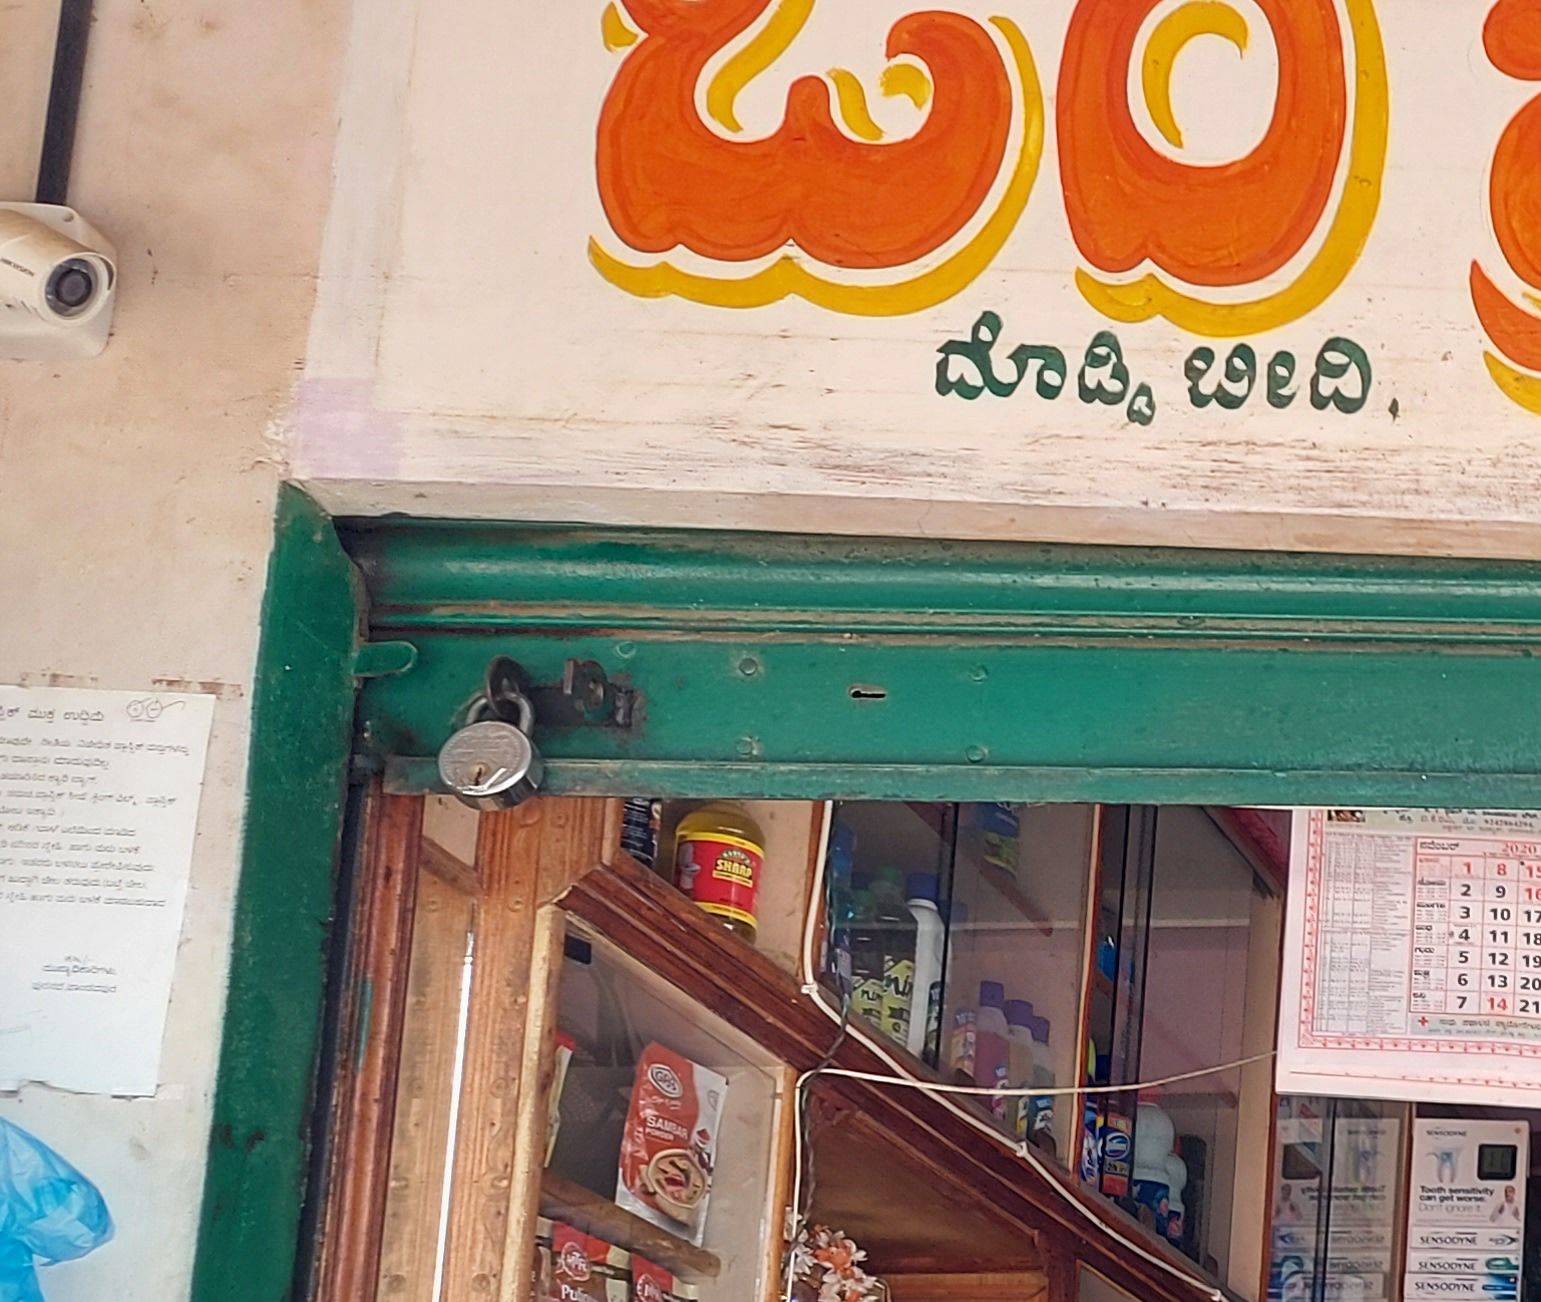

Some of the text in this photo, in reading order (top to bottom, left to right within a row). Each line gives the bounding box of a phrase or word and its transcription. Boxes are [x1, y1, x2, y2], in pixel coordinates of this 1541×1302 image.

[1502, 842, 1537, 855] 2020
[715, 858, 753, 879] SHARP
[1464, 863, 1472, 874] 1
[1497, 864, 1507, 876] 8
[1460, 884, 1472, 897] 2
[1495, 886, 1506, 898] 9
[1460, 907, 1471, 918] 3
[1490, 909, 1511, 920] 10
[1459, 929, 1471, 940] 4
[1490, 931, 1509, 943] 11
[1459, 951, 1469, 963] 5
[1489, 953, 1509, 965] 12
[1457, 973, 1468, 986] 6
[1488, 975, 1508, 987] 13
[1520, 978, 1541, 990] 20
[1457, 996, 1467, 1008] 7
[1488, 997, 1508, 1010] 14
[1519, 1000, 1540, 1013] 21
[647, 1115, 689, 1140] SAMBAR
[1420, 1185, 1495, 1196] Tooth sensitivity
[1439, 1195, 1454, 1203] get
[1420, 1236, 1477, 1244] SENSODYNE
[1418, 1262, 1475, 1270] SENSODYNE
[1415, 1282, 1474, 1291] SENSODYNE
